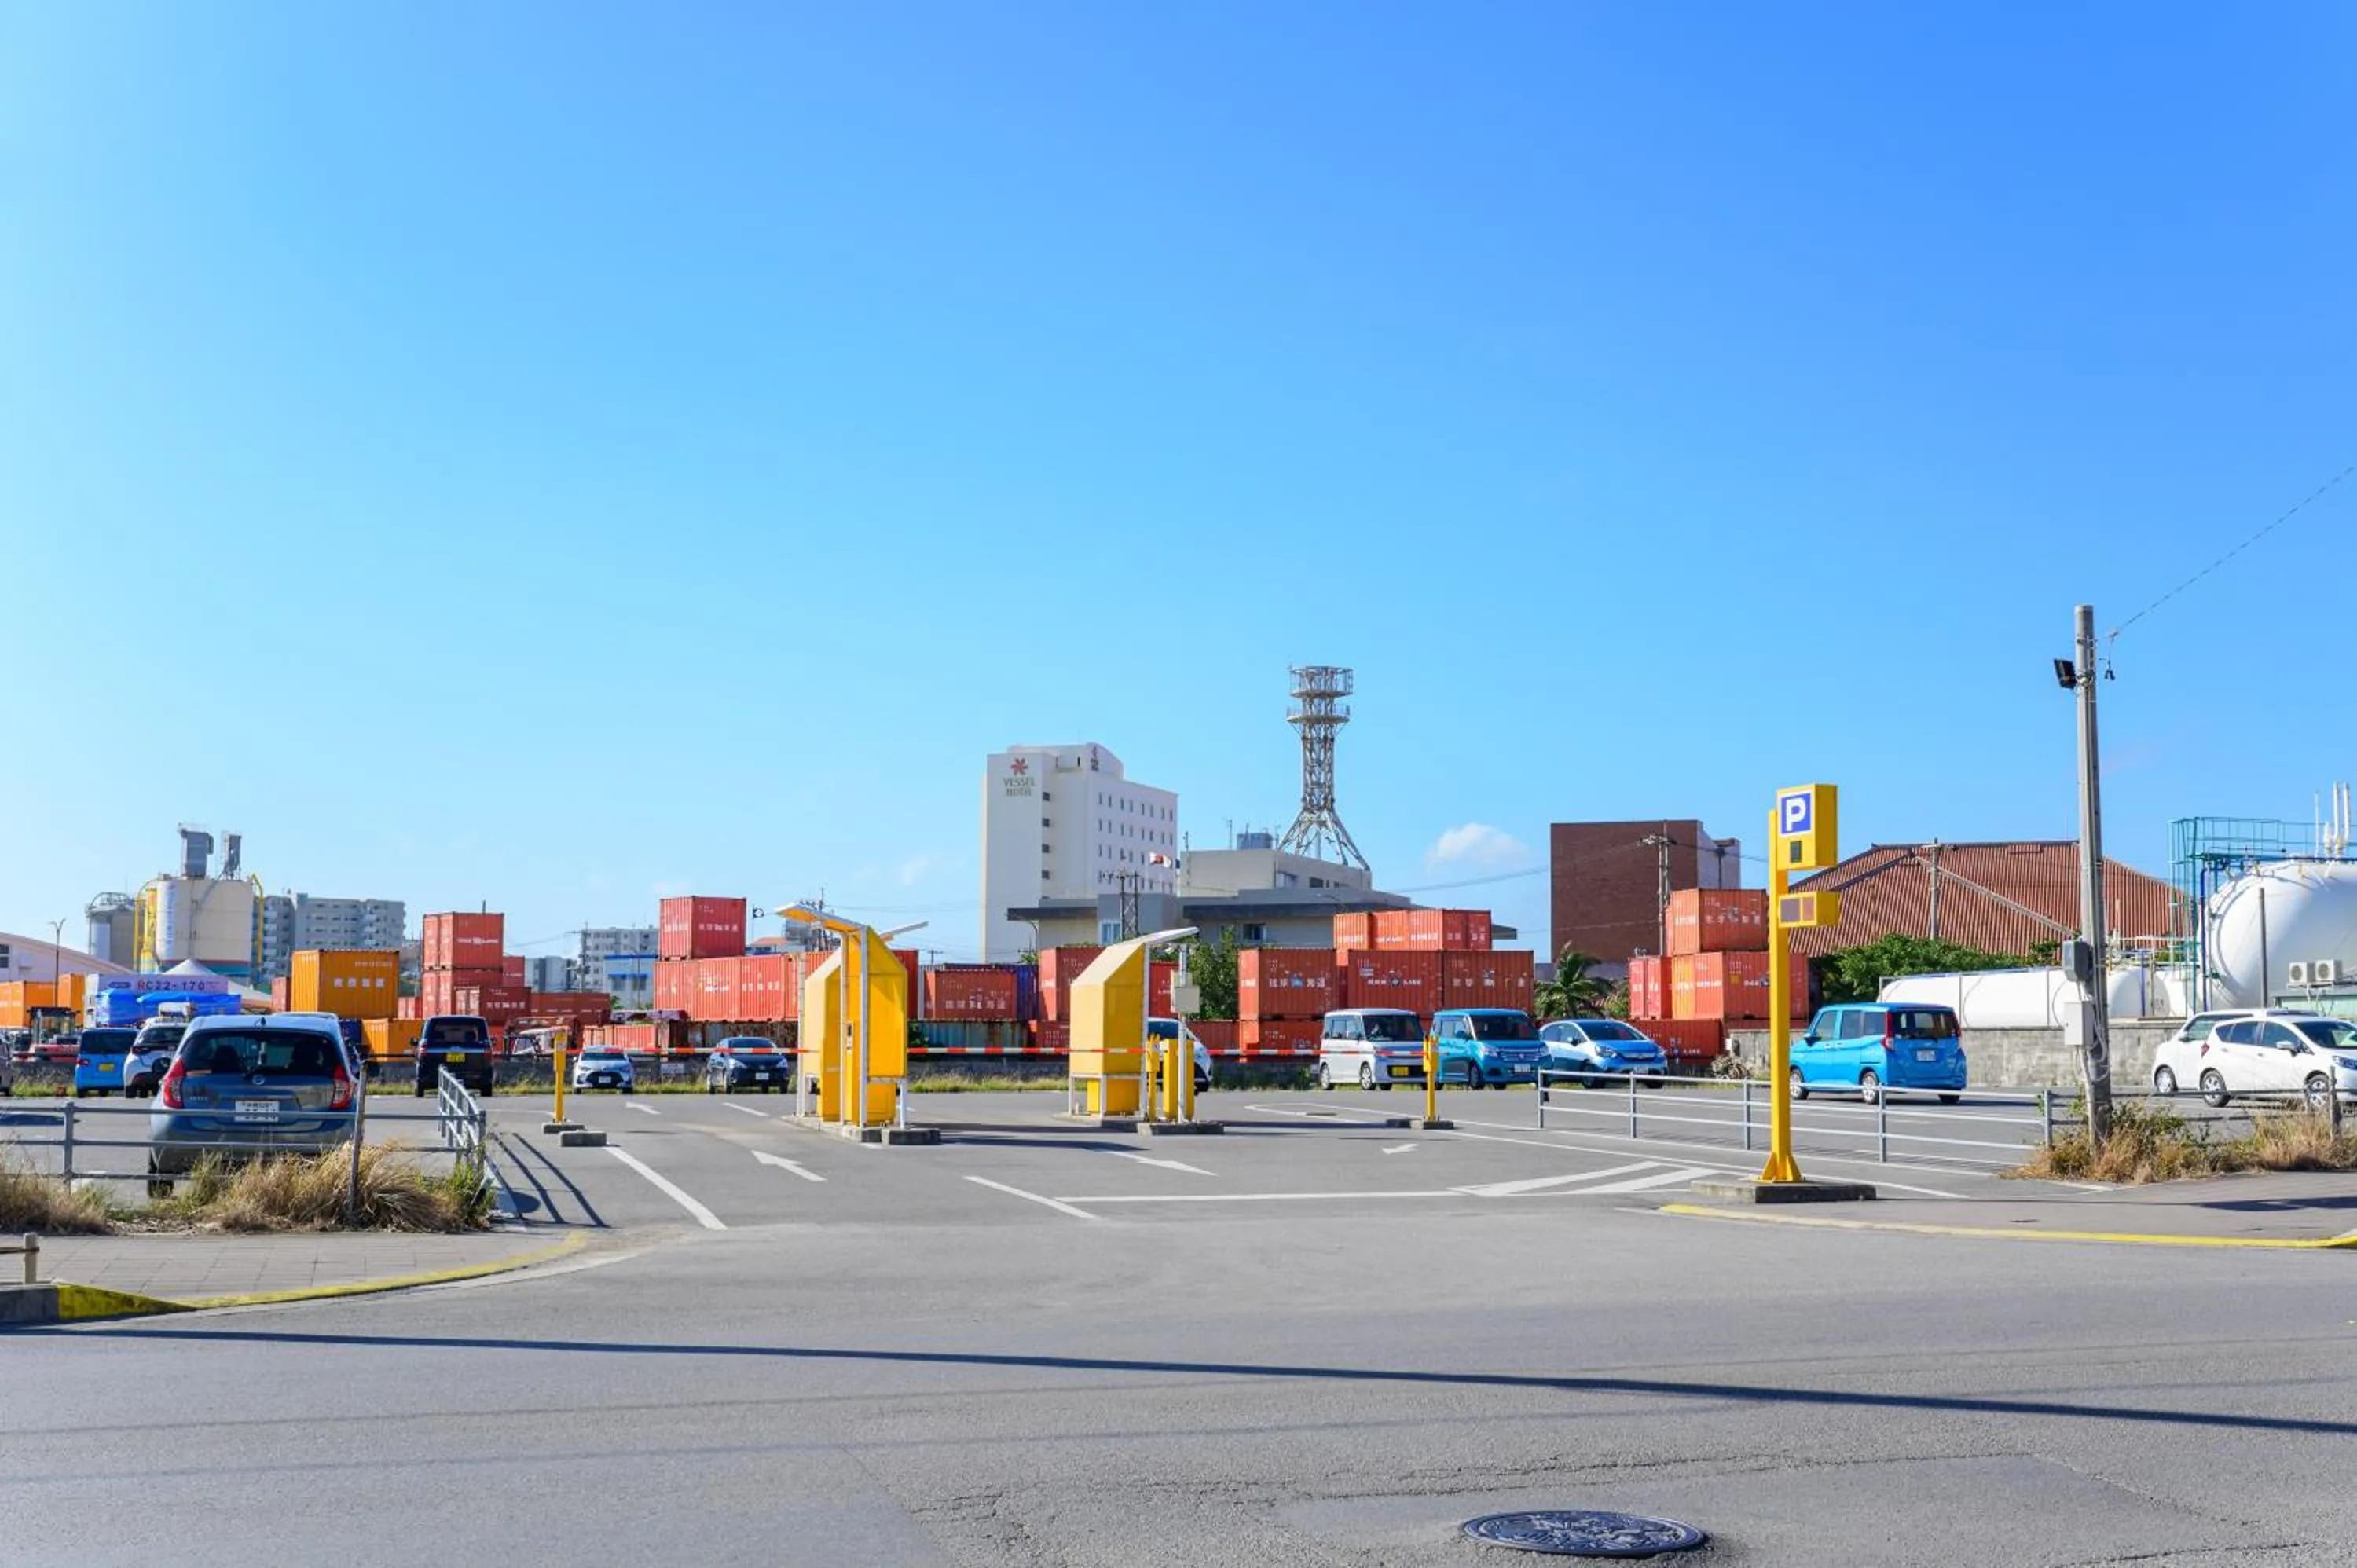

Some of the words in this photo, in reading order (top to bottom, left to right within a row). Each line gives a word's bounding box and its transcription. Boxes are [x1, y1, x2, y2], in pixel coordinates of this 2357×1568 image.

[1003, 777, 1035, 786] VESSEL
[1006, 788, 1032, 797] HOTEL
[1786, 797, 1807, 831] P
